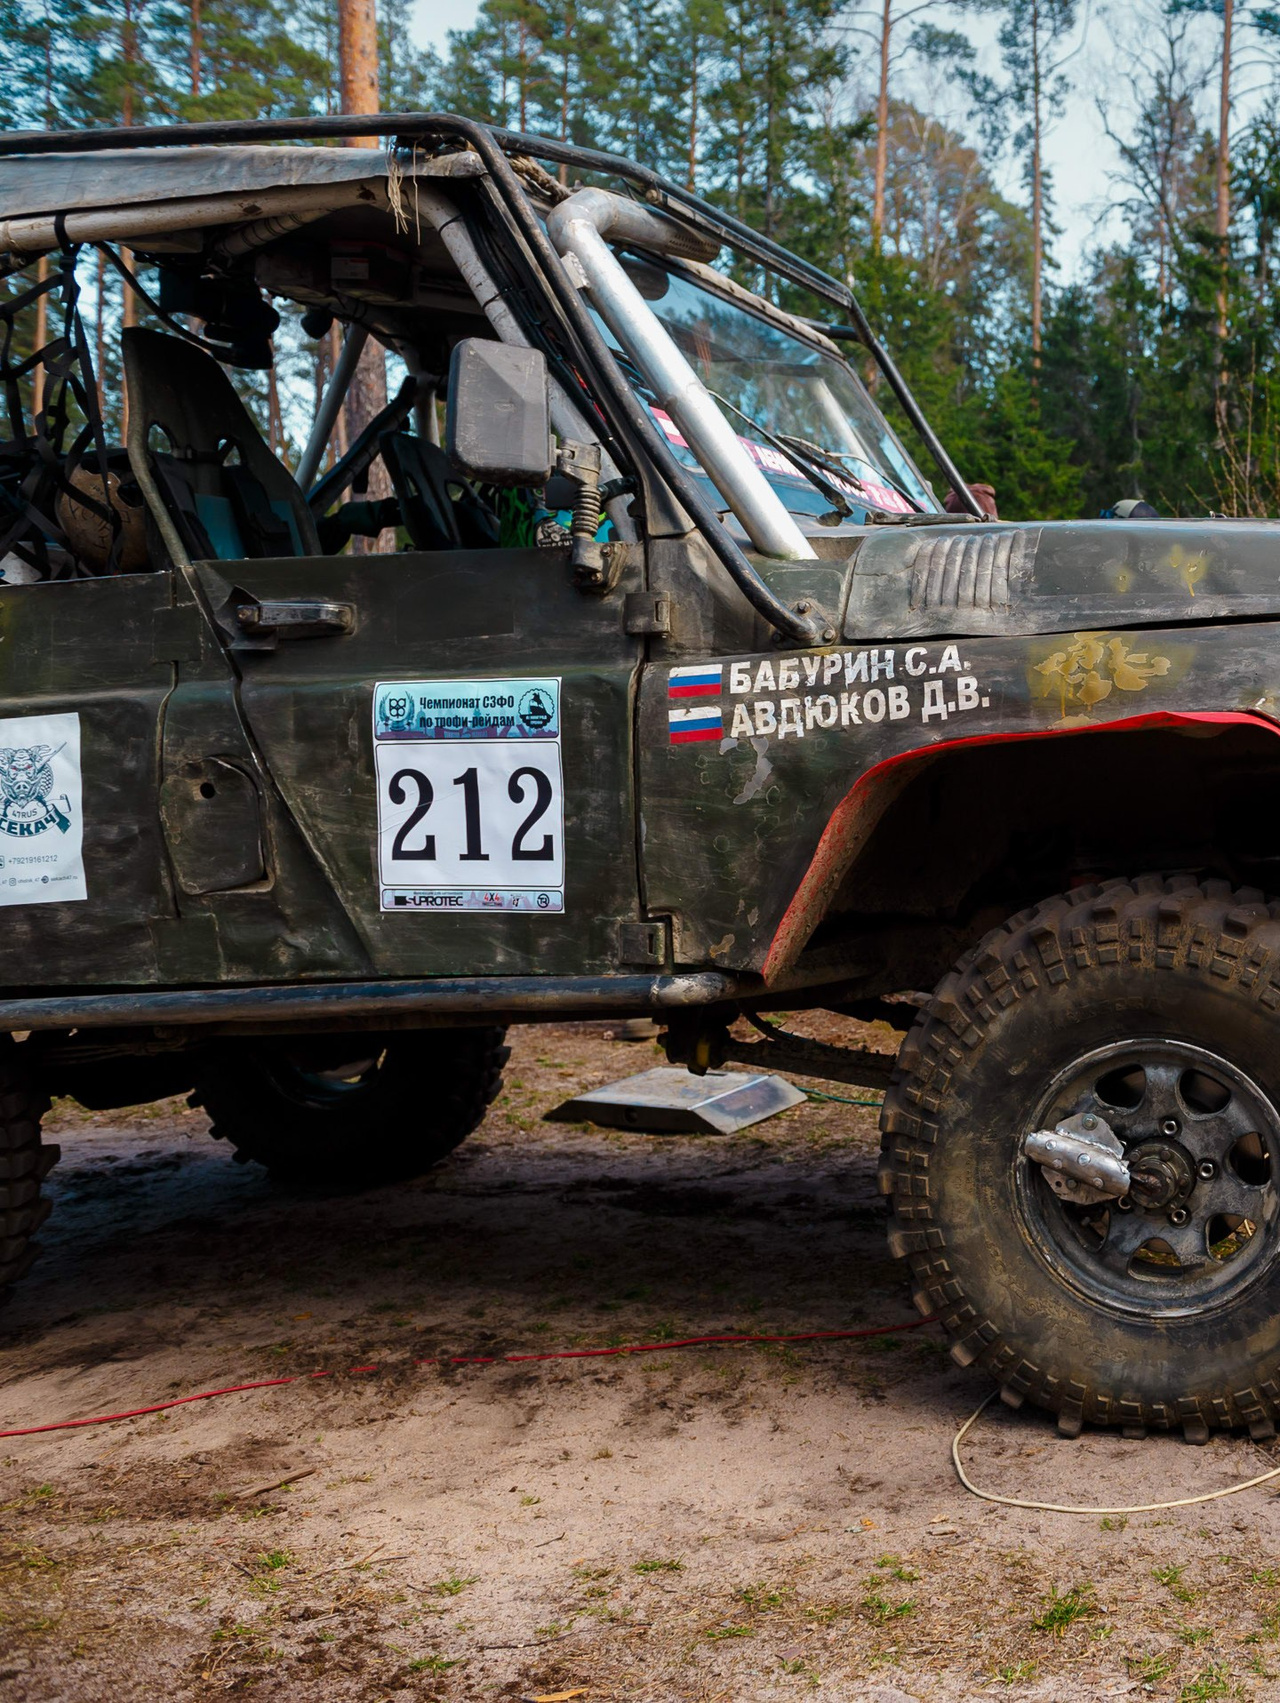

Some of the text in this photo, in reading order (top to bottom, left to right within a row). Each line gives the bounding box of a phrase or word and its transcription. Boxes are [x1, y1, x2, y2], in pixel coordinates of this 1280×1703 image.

[729, 649, 896, 694] БАБУРИН
[419, 694, 515, 711] Чемпионат СЗФО
[730, 685, 911, 740] АВДЮКОВ
[419, 716, 433, 729] по
[434, 713, 515, 730] трофи-рейдам
[12, 808, 38, 819] 47RUS
[388, 766, 555, 861] 212
[8, 854, 58, 865] +79219161212
